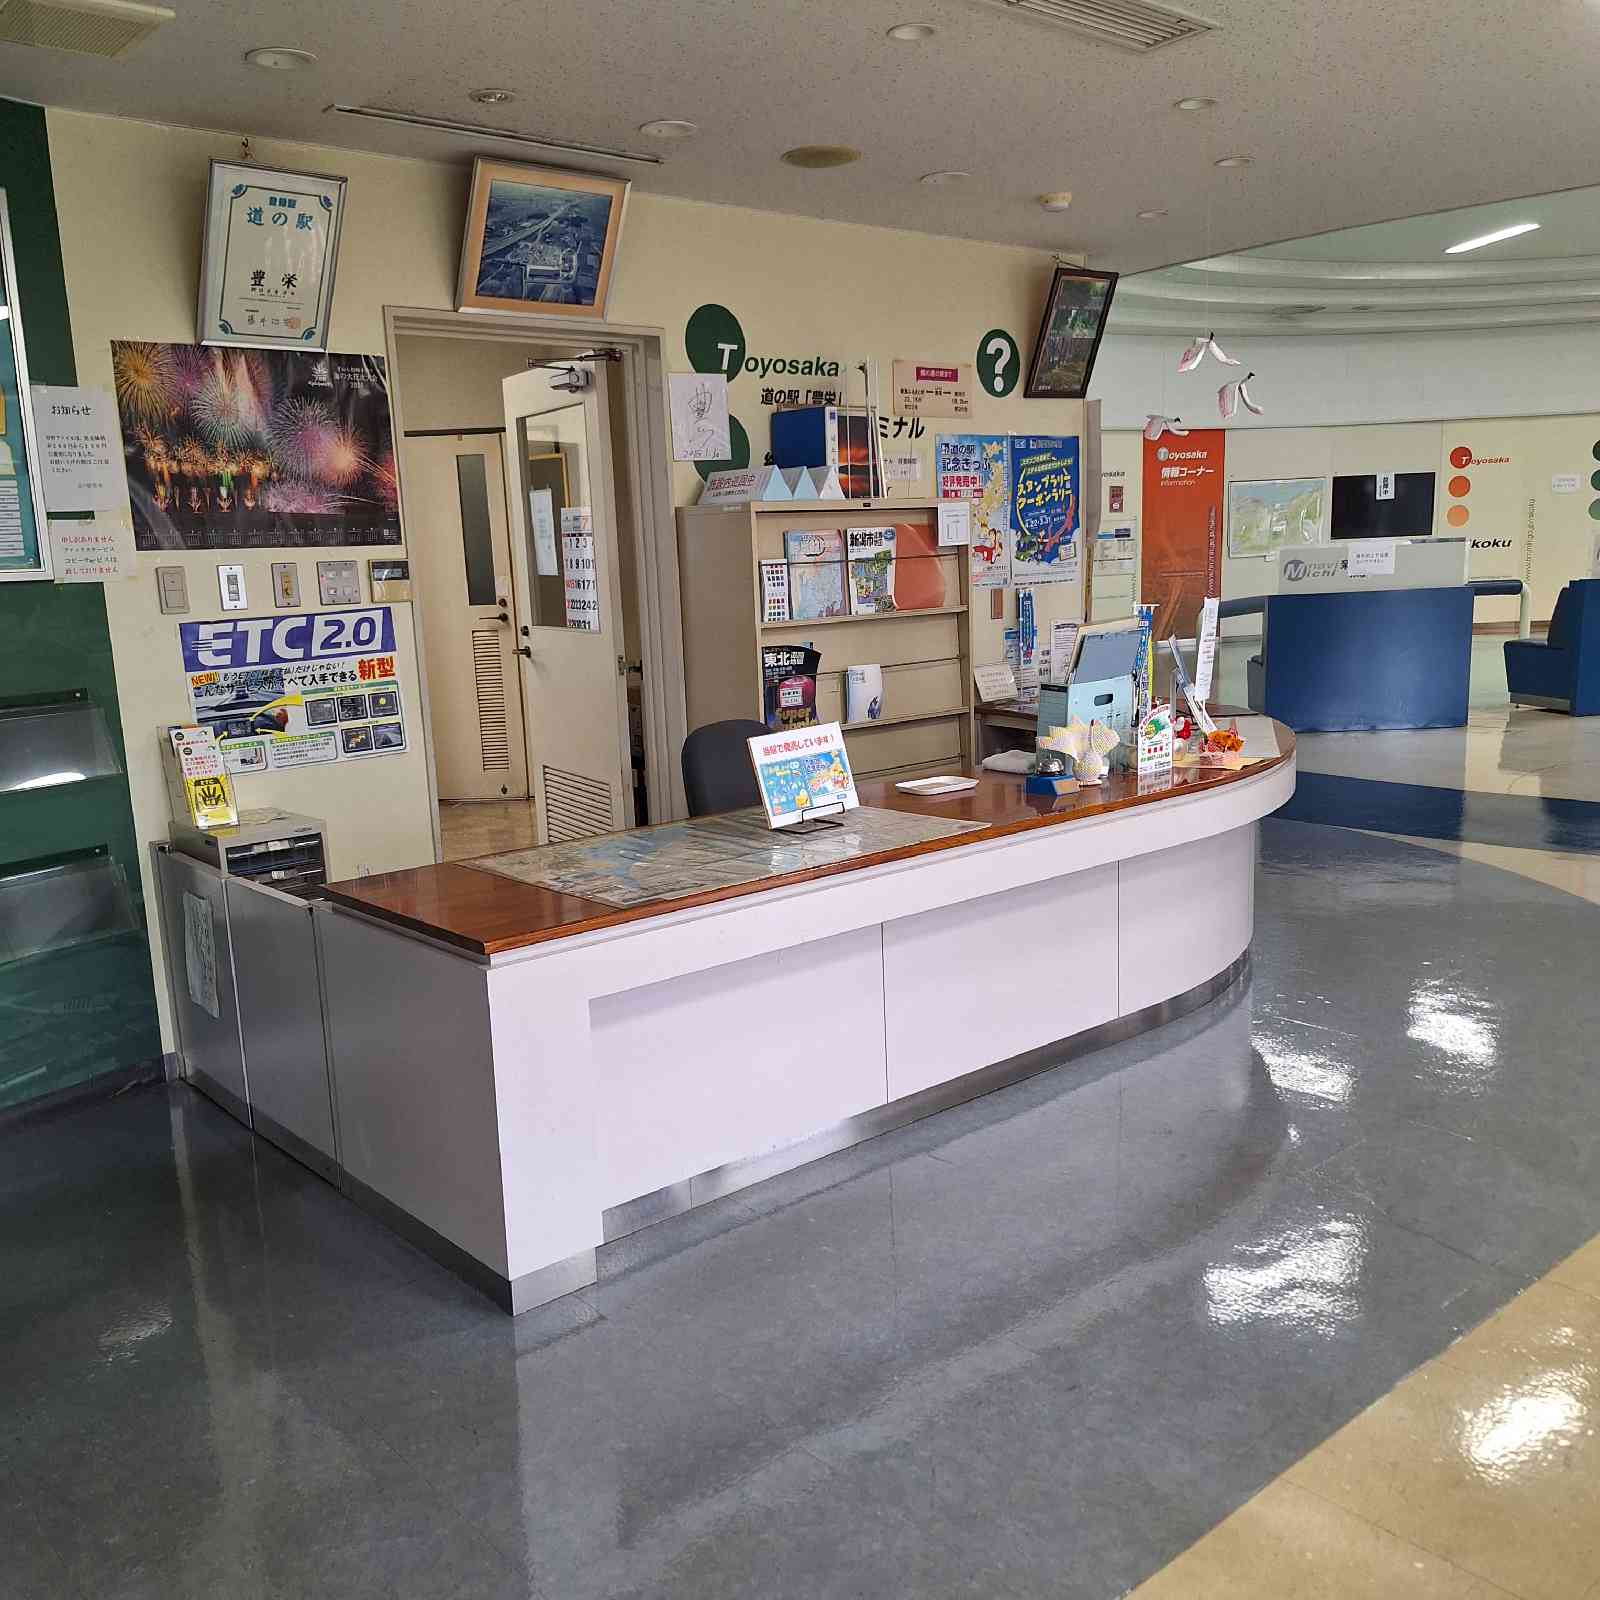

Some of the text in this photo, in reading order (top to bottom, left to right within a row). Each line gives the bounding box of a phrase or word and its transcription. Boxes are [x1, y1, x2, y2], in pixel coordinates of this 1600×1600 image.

[247, 207, 313, 231] 道の駅
[250, 269, 298, 289] 豊栄
[717, 342, 840, 379] Toyosaka
[51, 404, 92, 416] お知らせ
[1459, 456, 1511, 466] Toyosaka
[1160, 464, 1215, 479] 情報コーナー
[1471, 538, 1513, 549] koku
[191, 616, 376, 667] ETC 2.0
[357, 655, 396, 681] 新型
[763, 651, 791, 668] 東北
